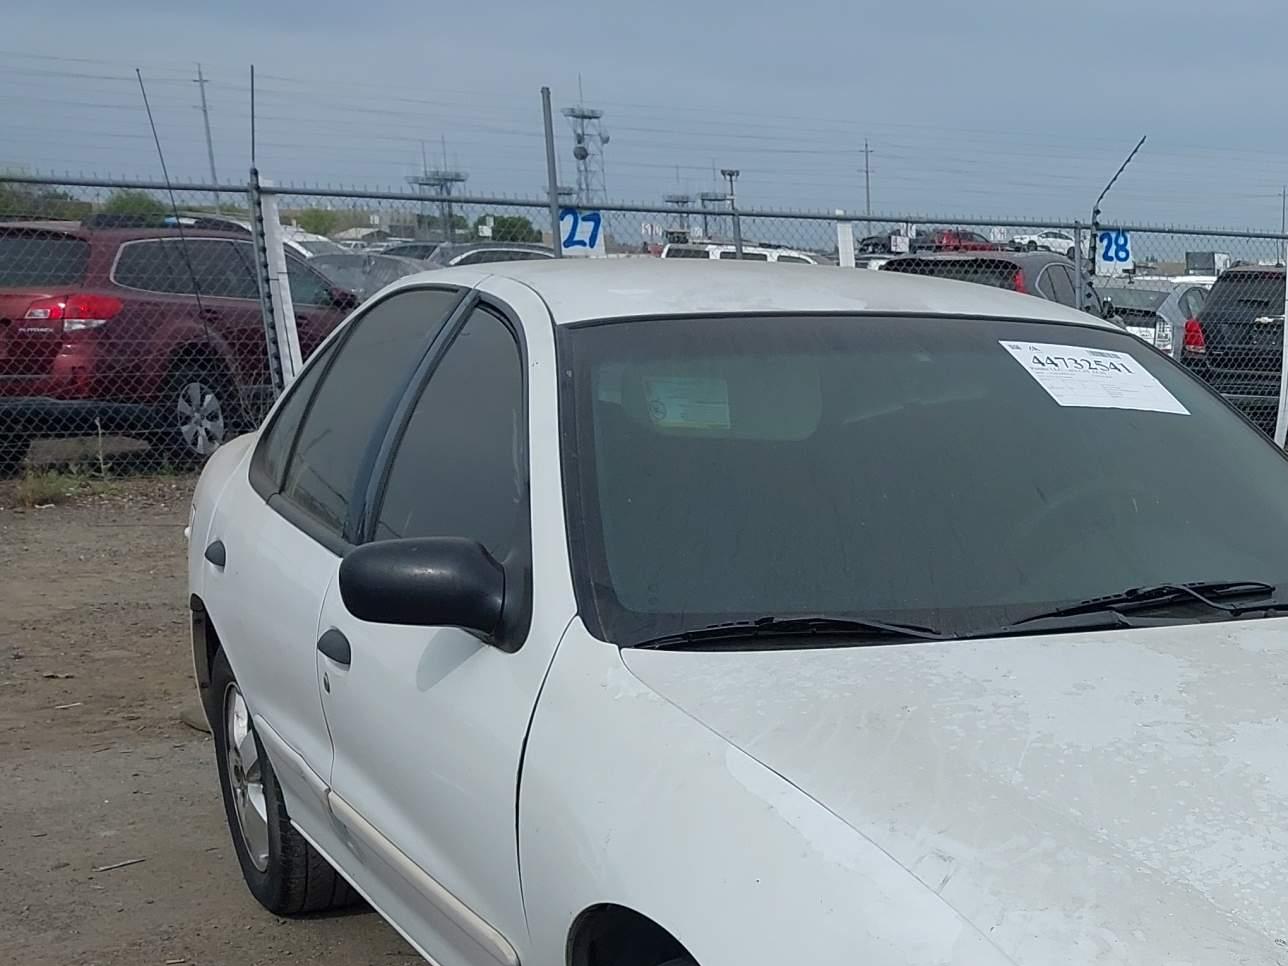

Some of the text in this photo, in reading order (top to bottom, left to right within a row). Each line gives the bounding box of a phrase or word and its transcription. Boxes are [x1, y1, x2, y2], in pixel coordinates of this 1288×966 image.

[560, 208, 601, 249] 27
[1099, 230, 1130, 262] 28
[1031, 355, 1132, 374] 44732541
